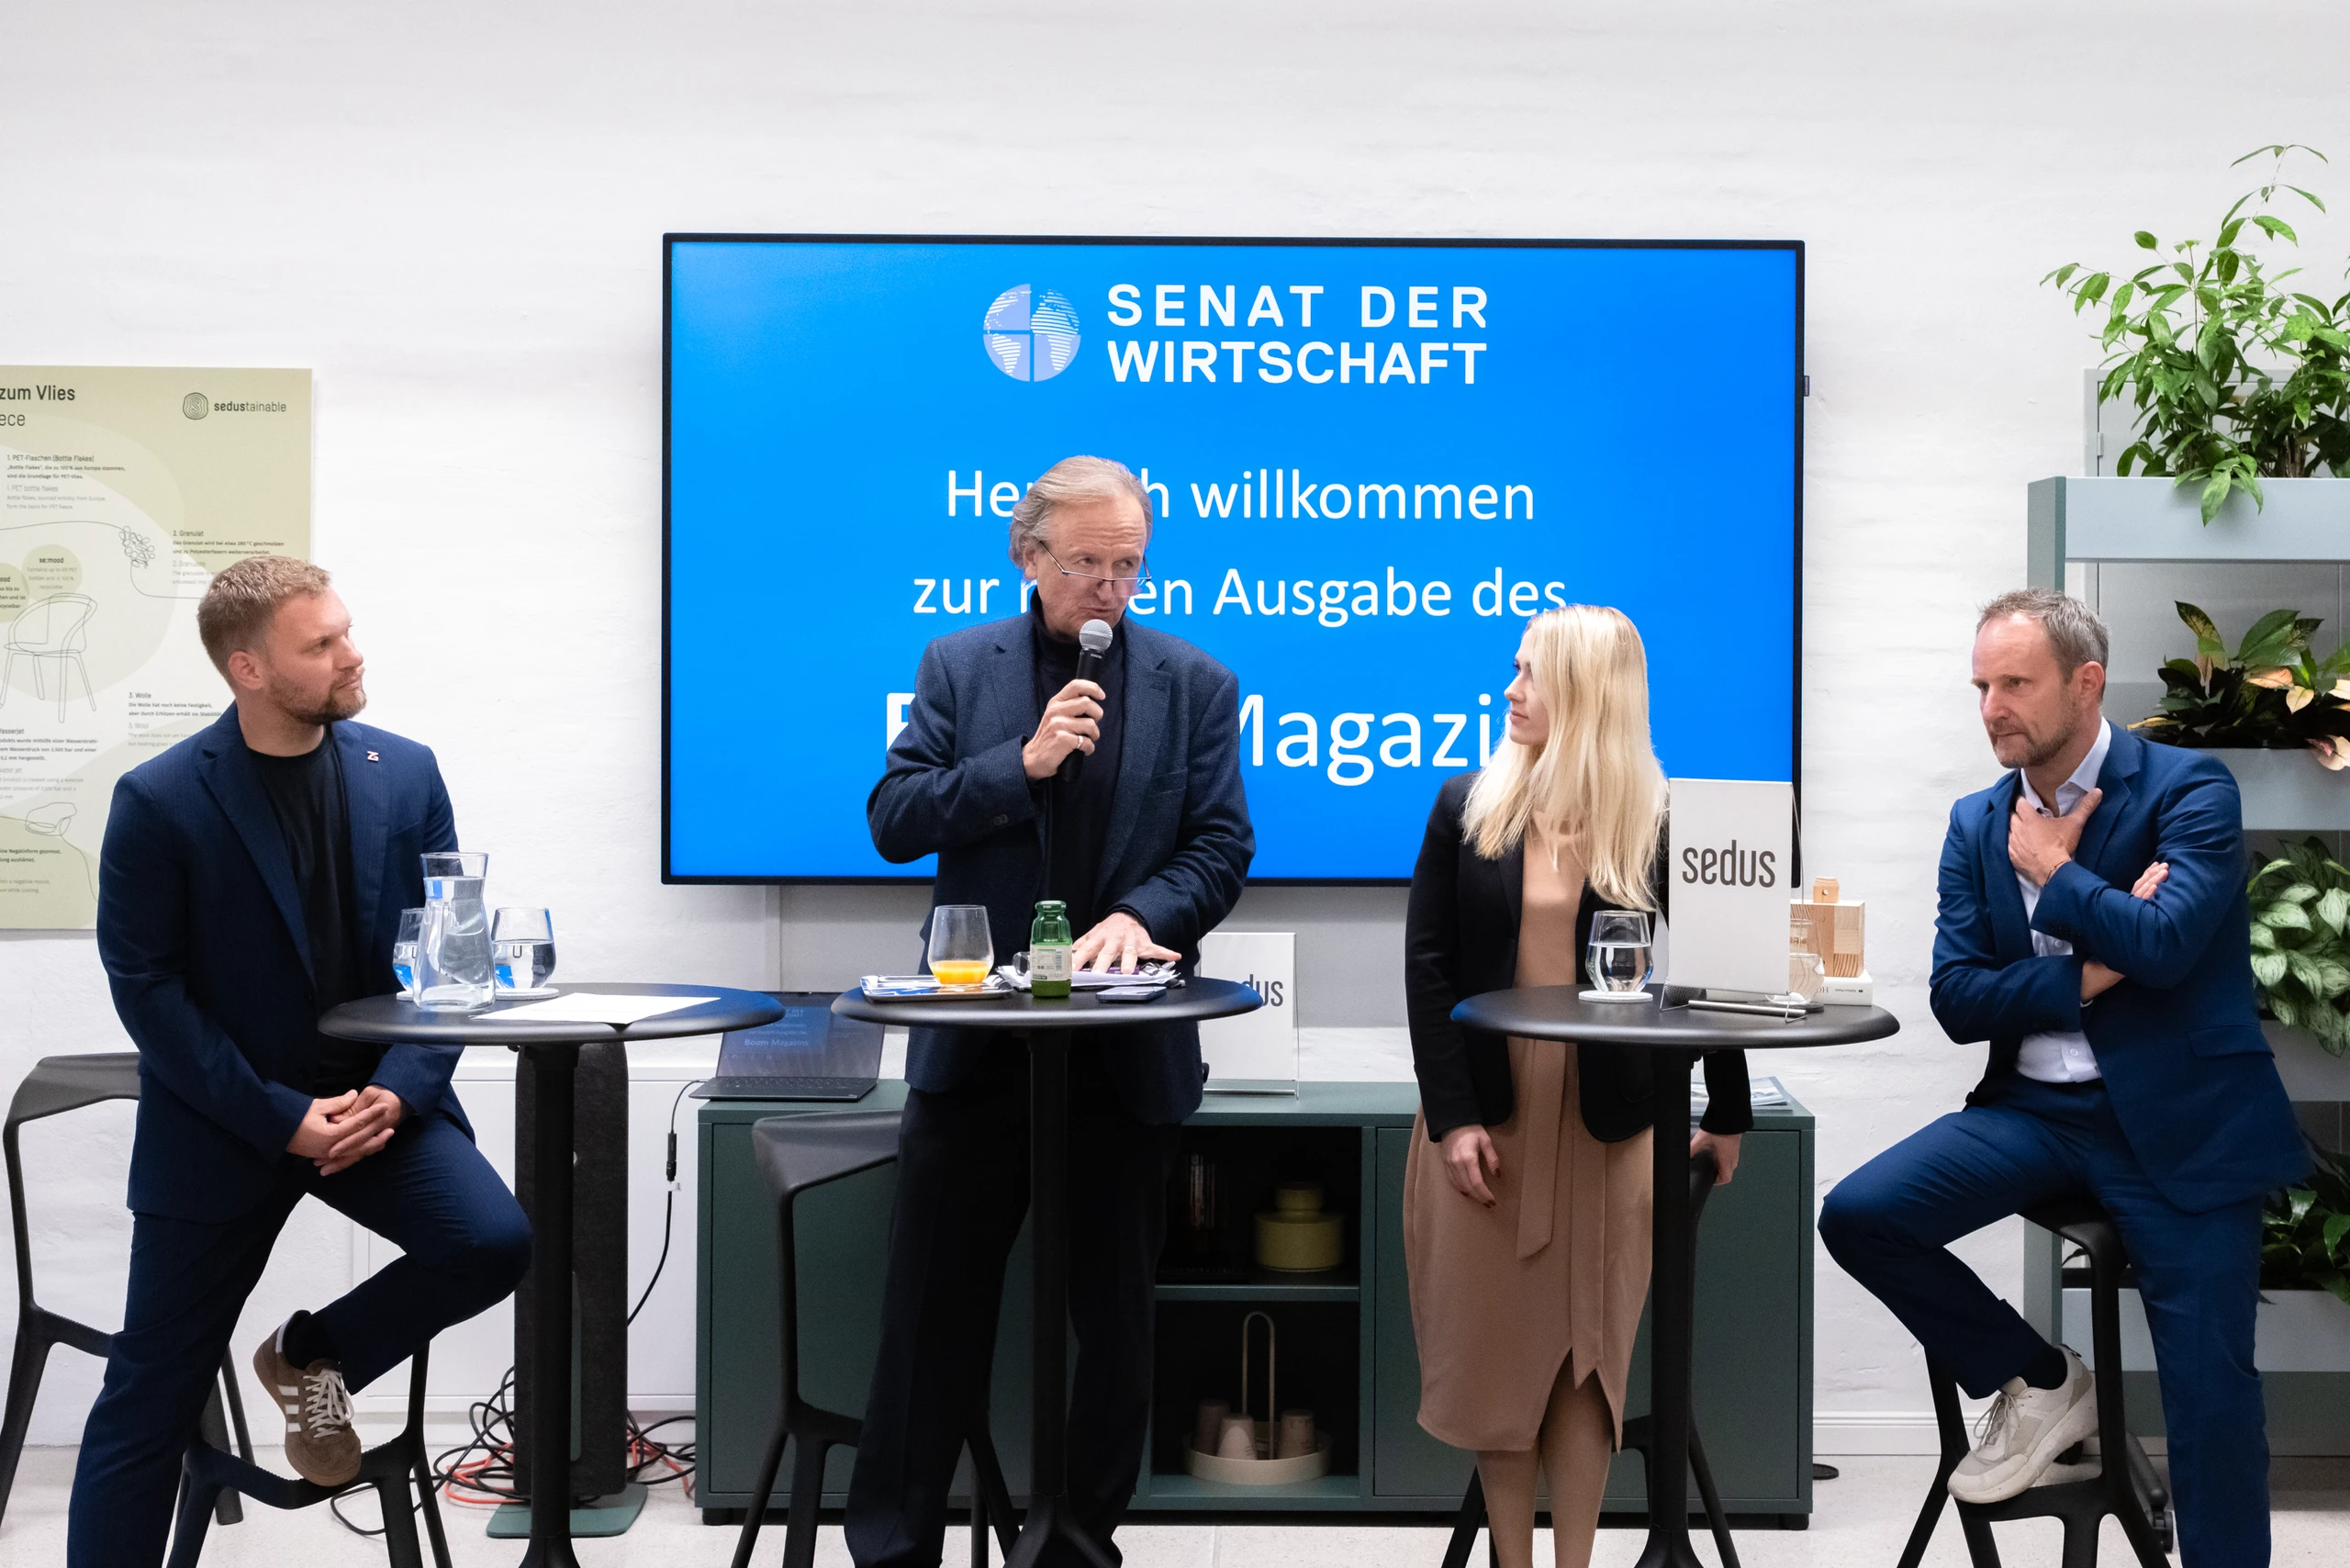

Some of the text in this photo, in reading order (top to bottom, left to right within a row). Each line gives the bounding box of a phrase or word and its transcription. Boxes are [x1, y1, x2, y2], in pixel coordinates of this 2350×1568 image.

[1107, 283, 1487, 328] SENAT DER
[1107, 340, 1487, 384] WIRTSCHAFT
[0, 385, 75, 401] zum Vlies
[214, 401, 286, 412] sedustainable
[1190, 470, 1534, 520] willkommen
[914, 578, 1000, 614] zur
[1212, 566, 1452, 628] Ausgabe
[1472, 566, 1567, 617] des
[1682, 840, 1776, 888] sedus
